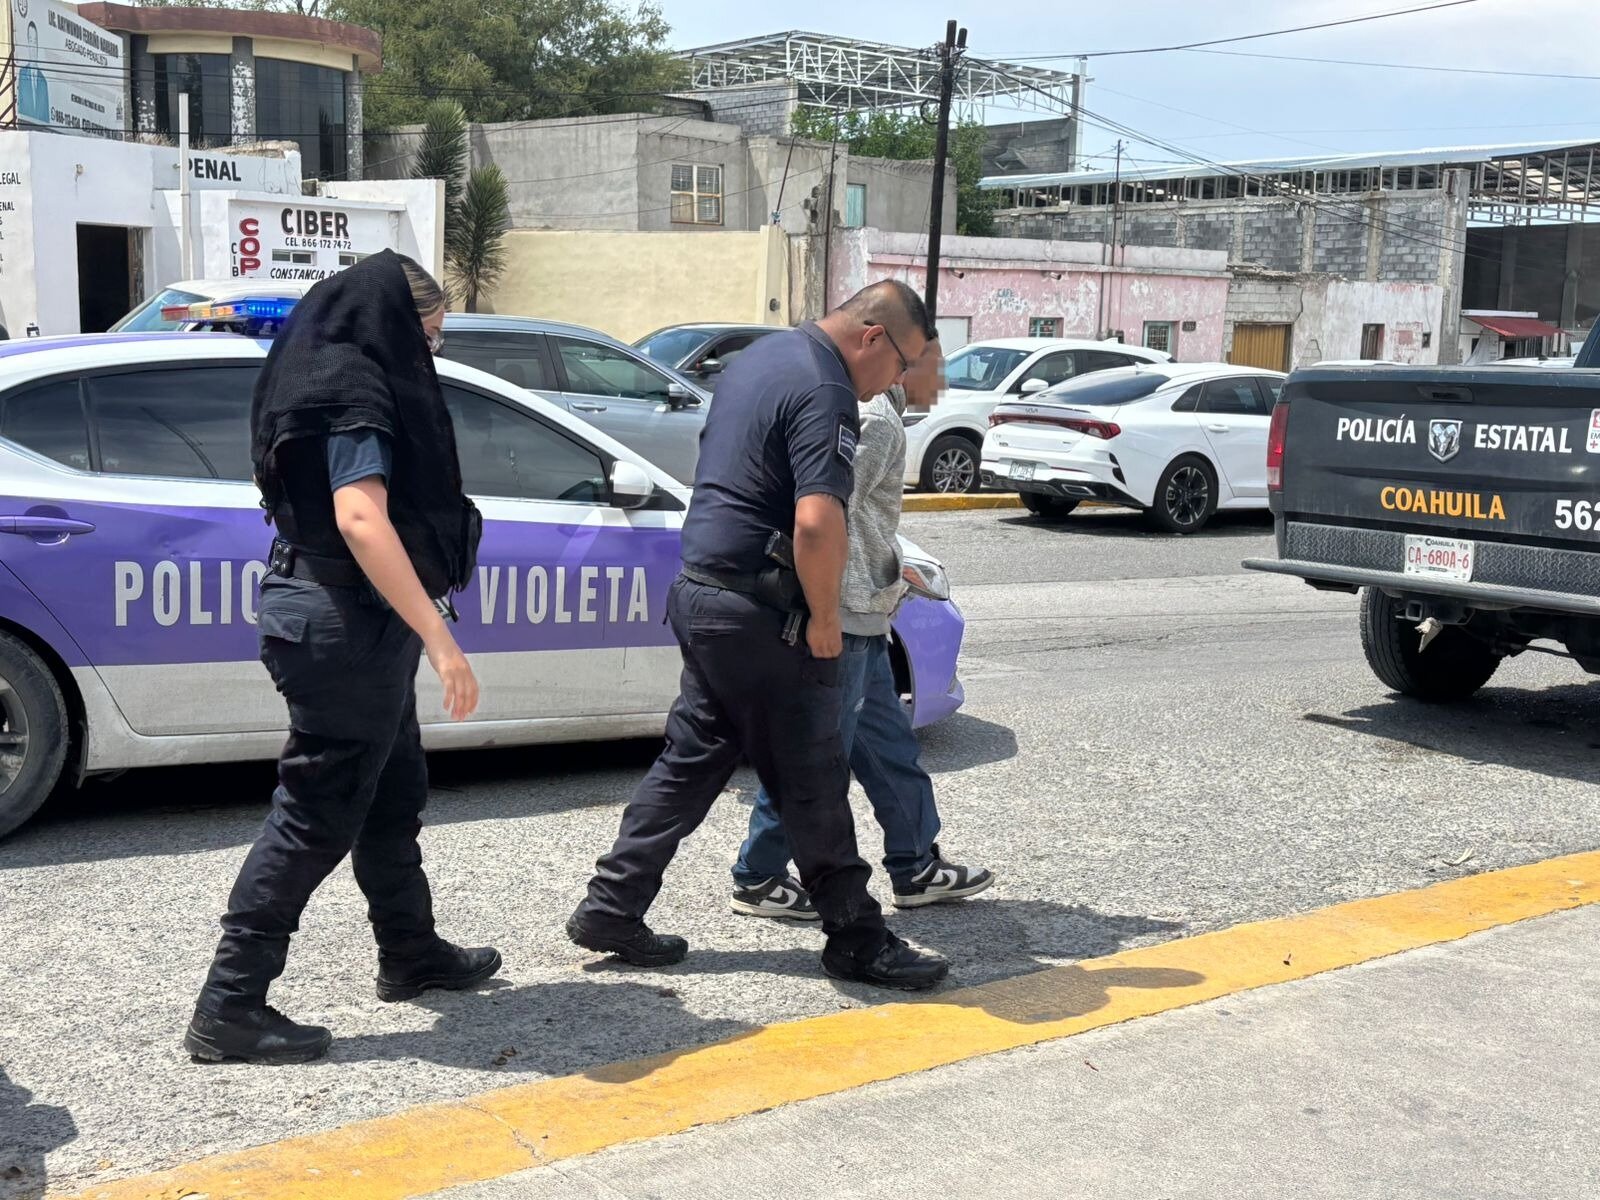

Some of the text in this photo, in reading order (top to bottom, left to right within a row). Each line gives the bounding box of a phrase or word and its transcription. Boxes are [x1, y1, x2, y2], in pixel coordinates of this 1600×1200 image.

[0, 172, 21, 185] EGAL
[281, 208, 349, 238] CIBER
[285, 236, 301, 248] CEL.
[270, 267, 326, 281] CONSTANCIA
[1336, 414, 1572, 454] POLICÍA ESTATAL
[1380, 486, 1506, 520] COAHUILA
[1408, 546, 1470, 570] CA-680A-6
[114, 560, 649, 627] POLIC VIOLETA
